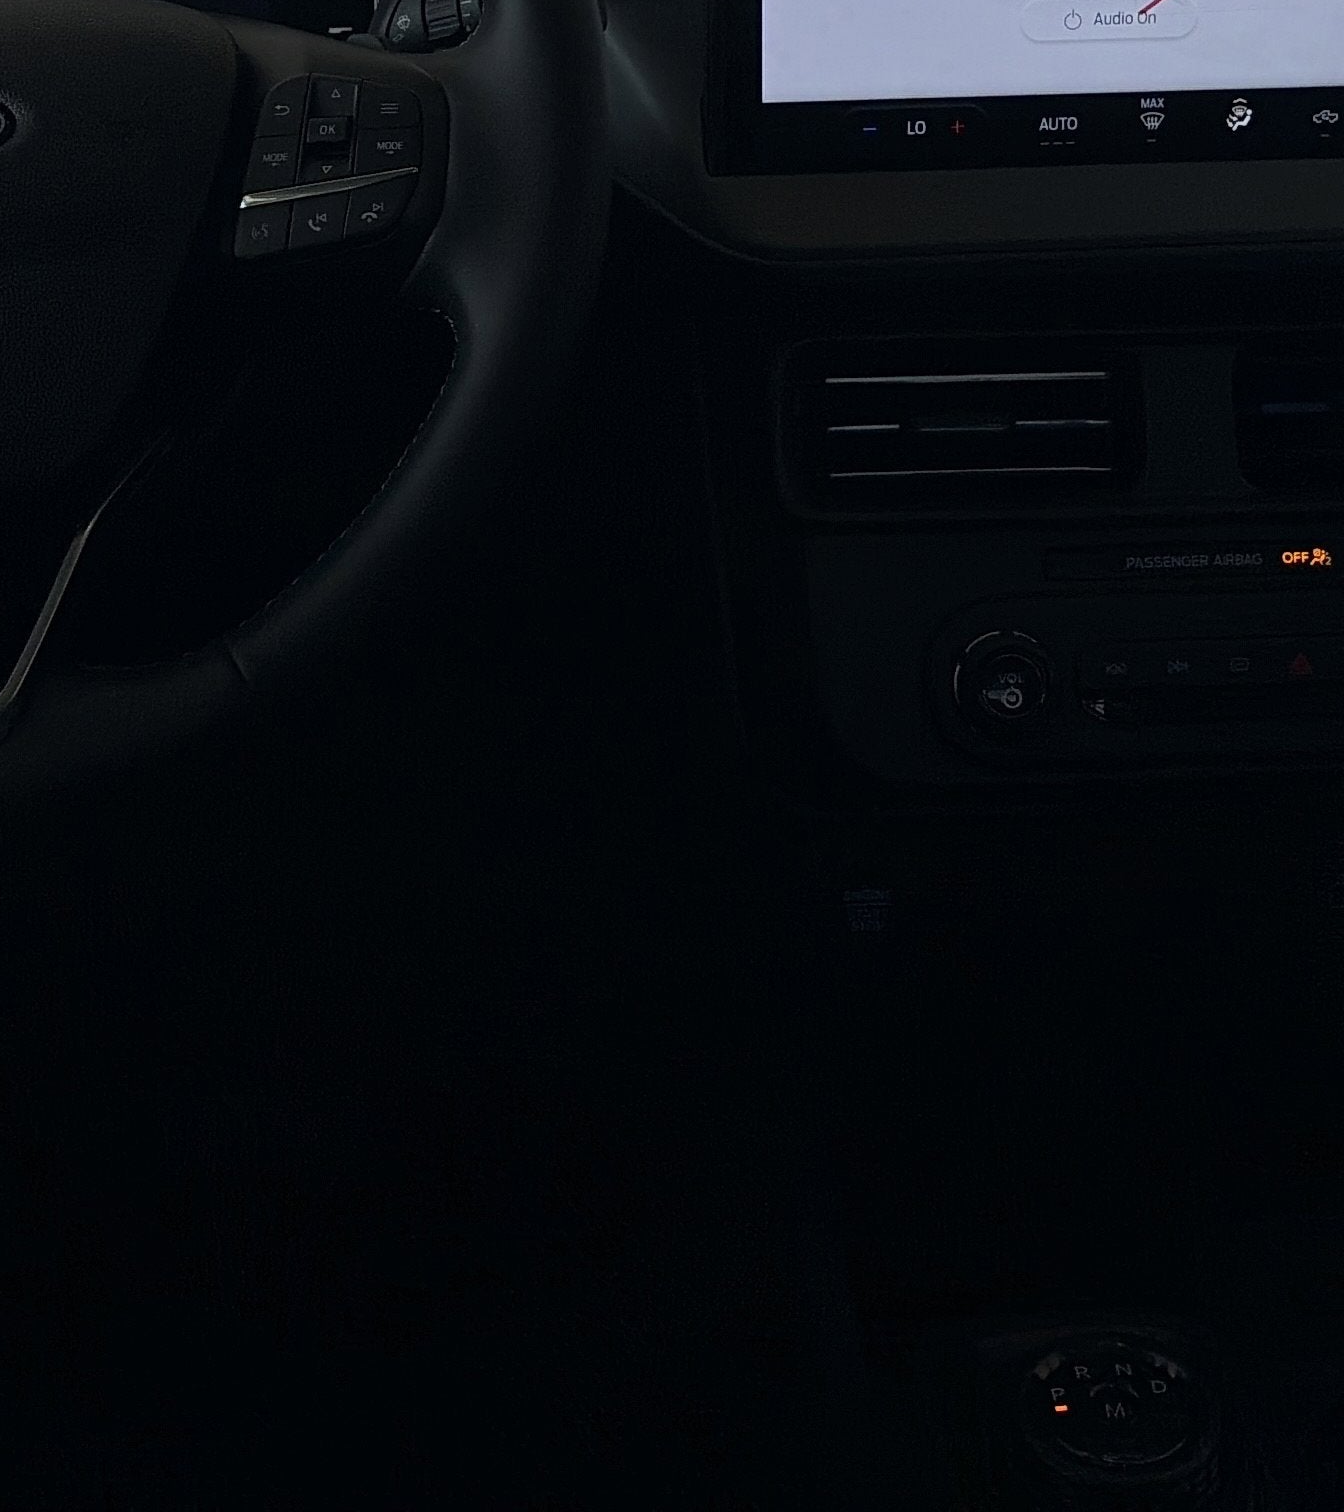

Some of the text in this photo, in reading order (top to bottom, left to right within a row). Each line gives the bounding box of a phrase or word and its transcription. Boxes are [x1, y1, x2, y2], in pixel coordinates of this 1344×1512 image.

[1093, 10, 1157, 26] Audio On
[1140, 97, 1166, 109] MAX
[318, 123, 337, 136] OK
[906, 119, 927, 136] LO
[1038, 115, 1079, 132] AUTO
[376, 140, 405, 151] MODE
[262, 152, 289, 163] MODE
[1125, 553, 1209, 570] PASSENGER
[1212, 552, 1265, 567] AIRBAG
[1281, 550, 1310, 565] OFF
[998, 672, 1025, 684] VOL
[1072, 1362, 1133, 1380] R N
[1050, 1379, 1168, 1402] P D
[1105, 1401, 1127, 1419] M
